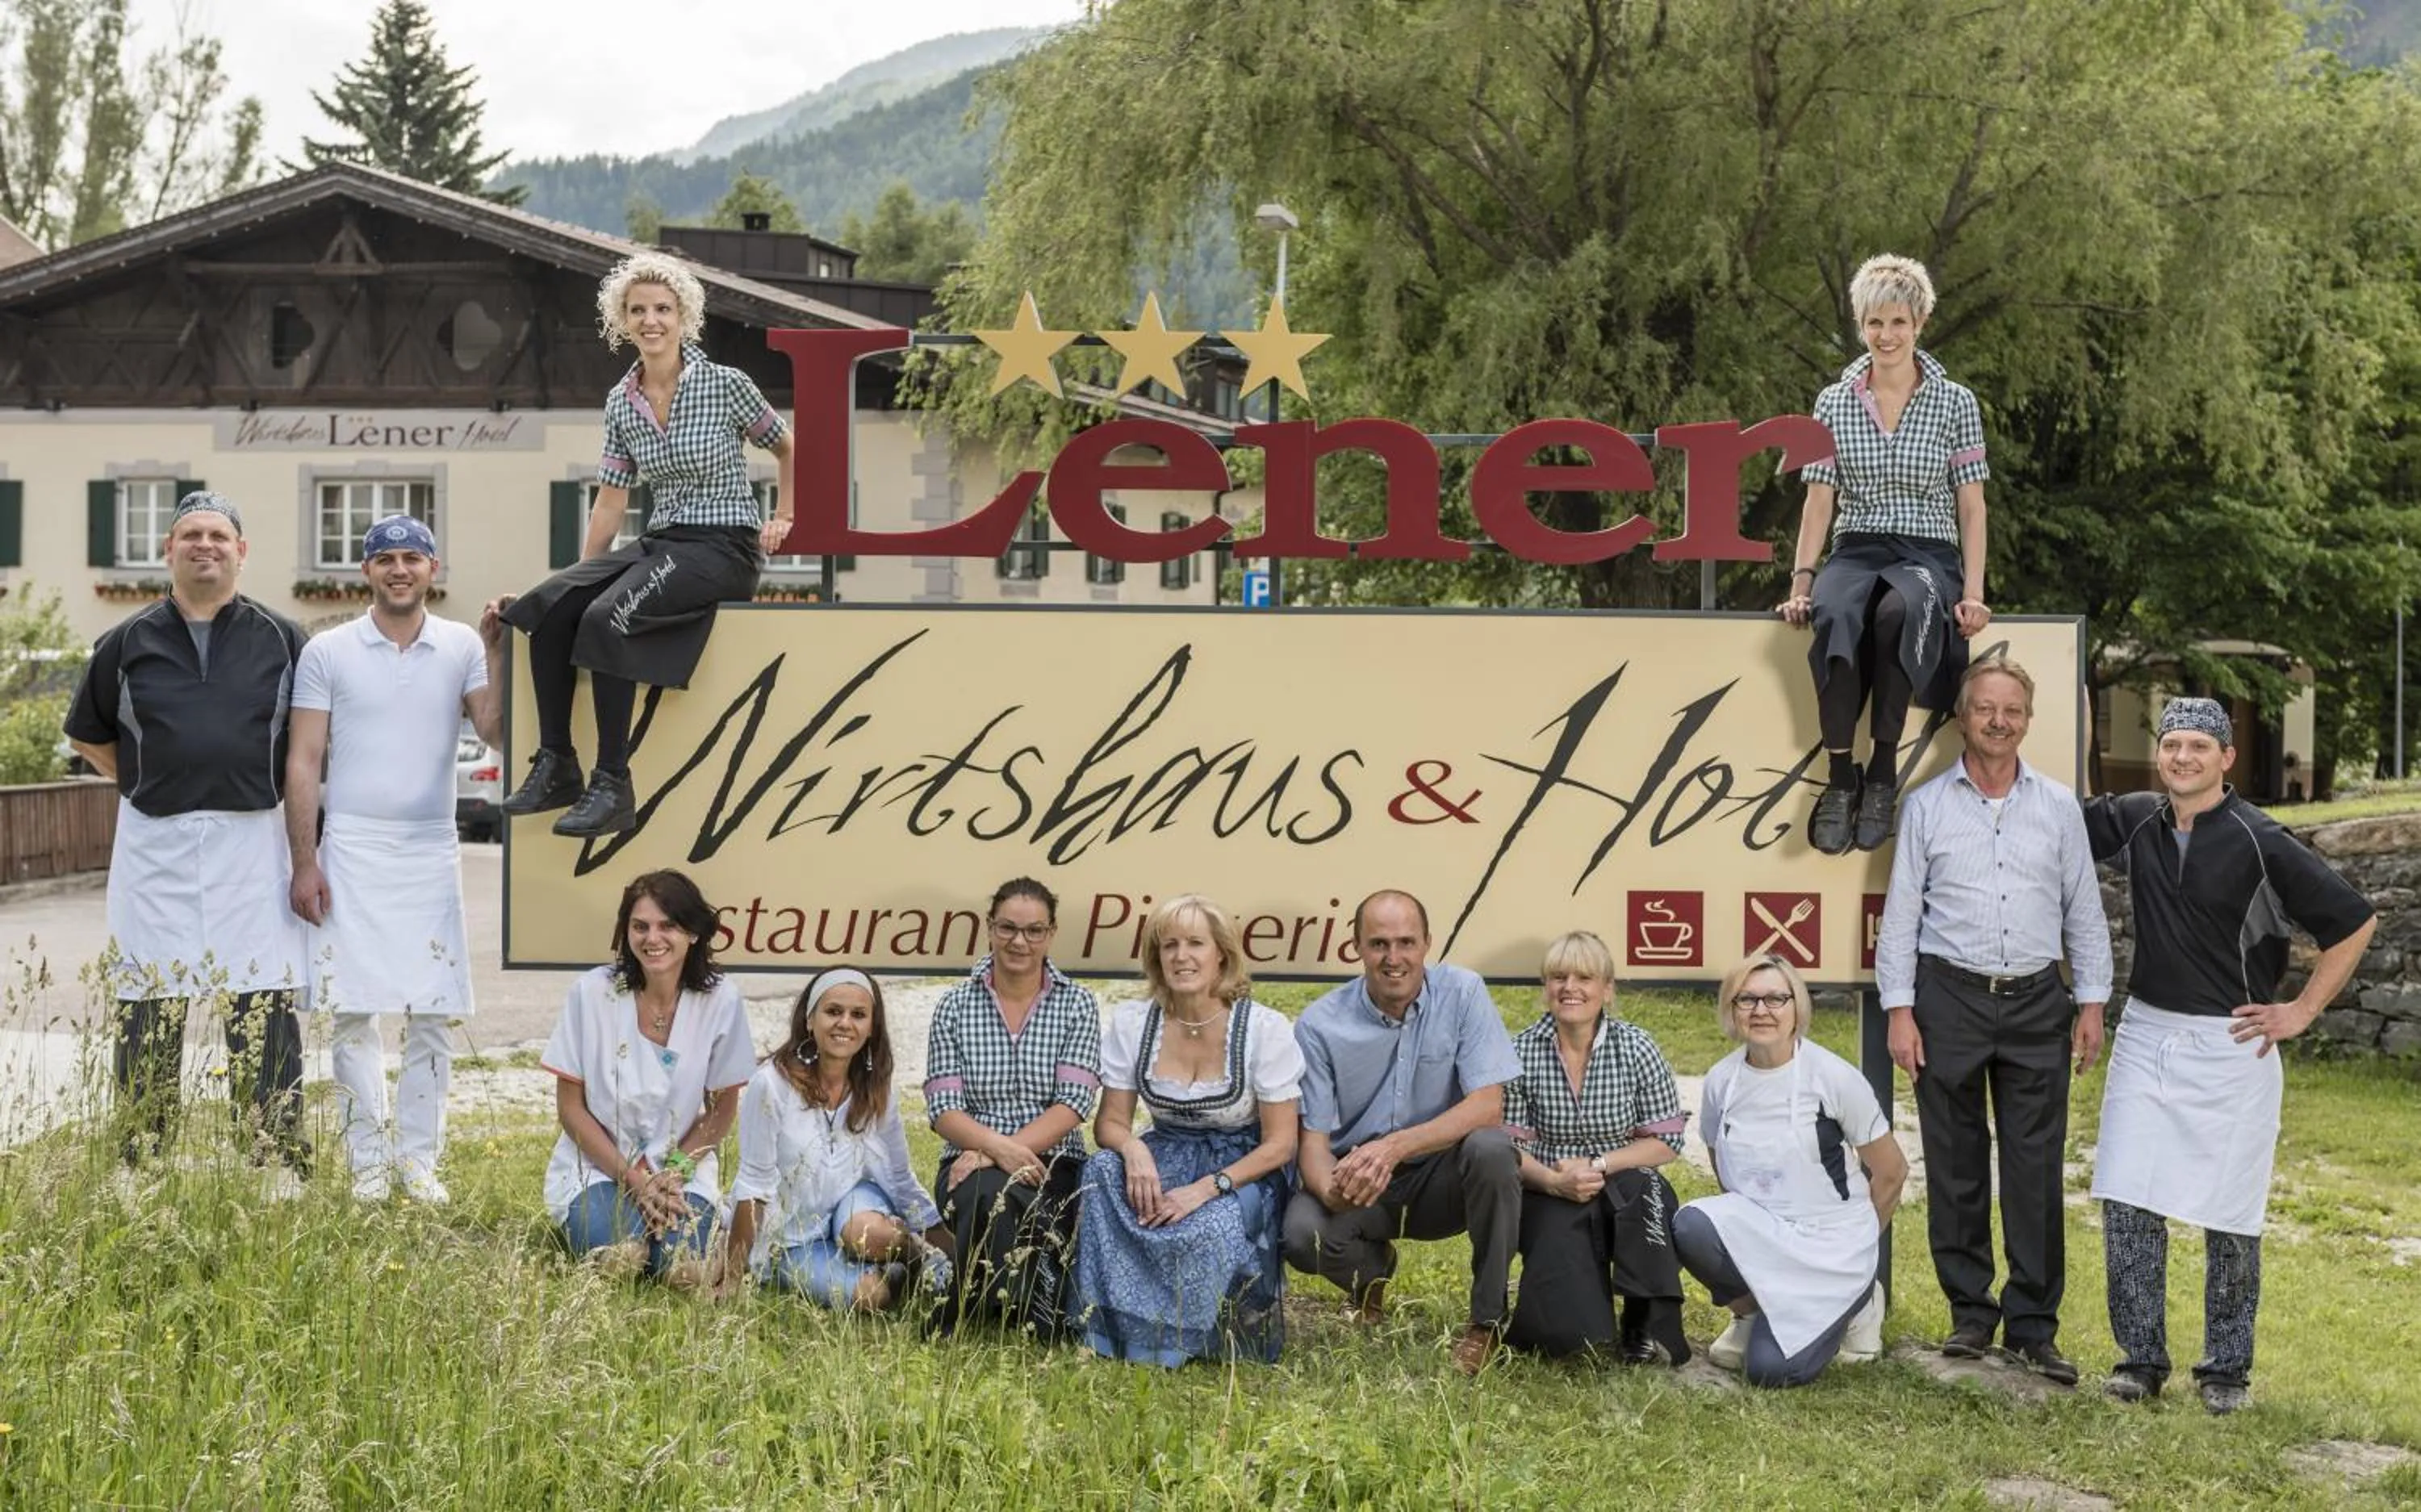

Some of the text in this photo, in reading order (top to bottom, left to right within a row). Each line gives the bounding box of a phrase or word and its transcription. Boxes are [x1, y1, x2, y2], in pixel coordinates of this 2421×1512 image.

[327, 413, 454, 446] Lener
[767, 327, 1836, 566] Lener
[1251, 576, 1269, 607] P
[574, 628, 1365, 878] Wirtshaus
[1387, 759, 1482, 825] &
[611, 893, 1362, 963] stauran Pieria
